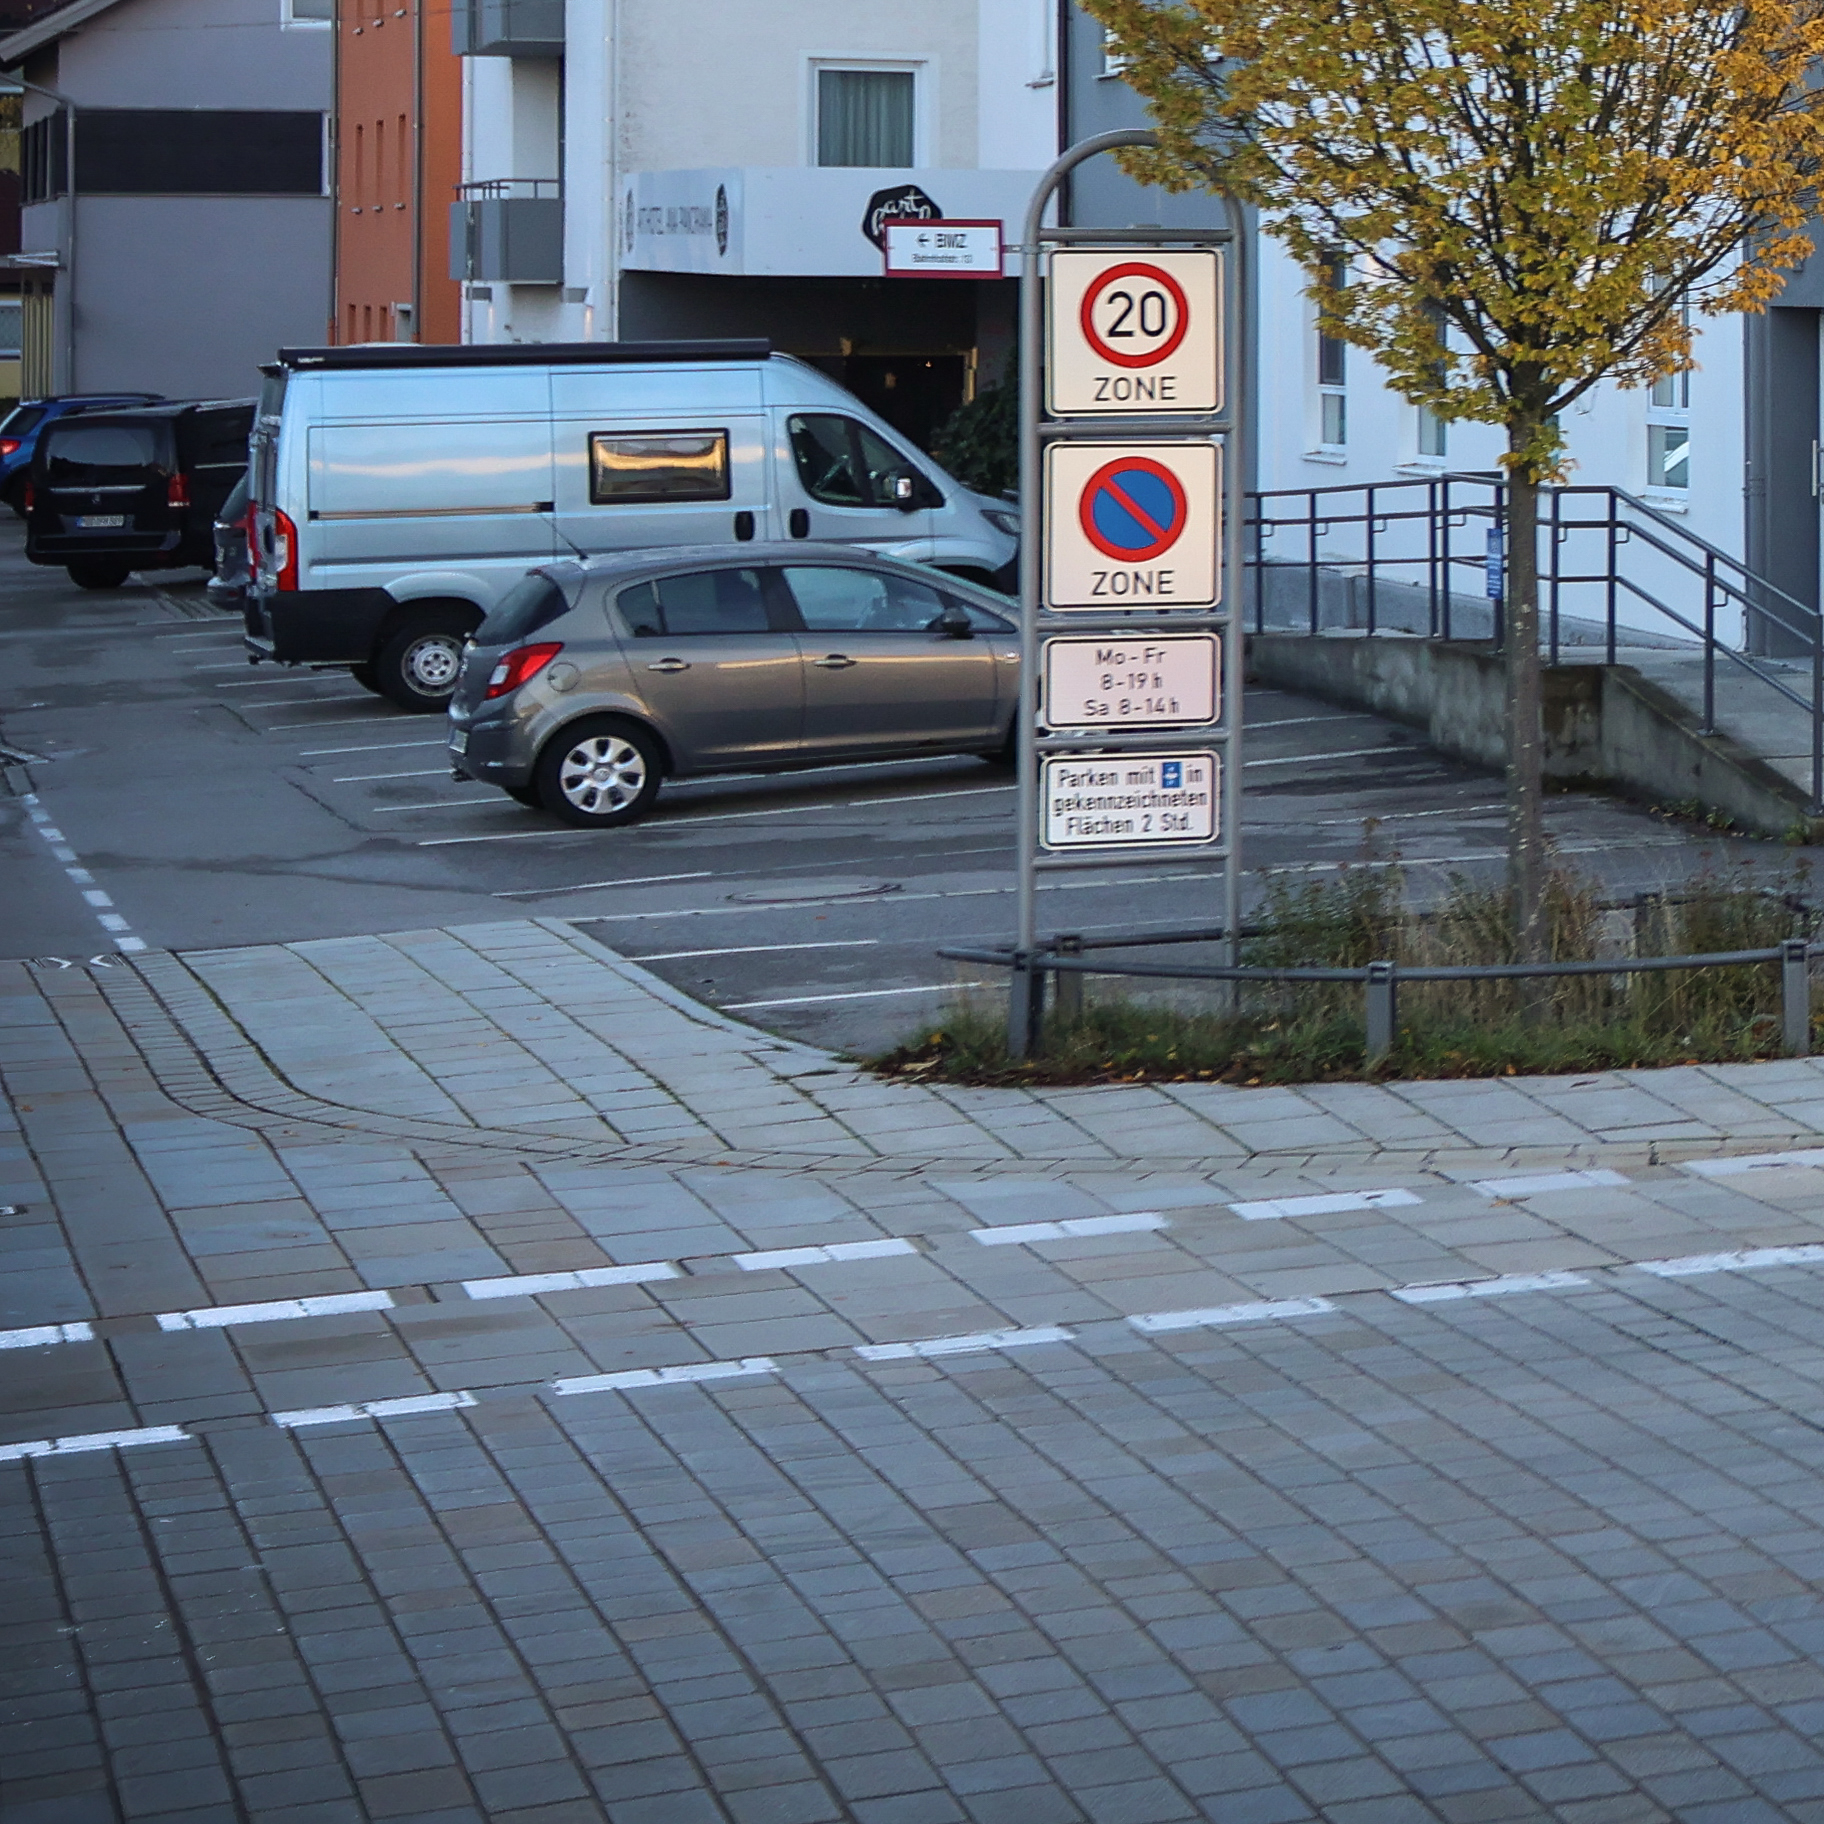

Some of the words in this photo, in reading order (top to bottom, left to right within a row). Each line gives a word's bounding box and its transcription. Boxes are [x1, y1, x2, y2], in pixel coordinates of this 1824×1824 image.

[884, 188, 924, 214] art
[1106, 291, 1165, 338] 20
[1093, 375, 1178, 402] ZONE
[1091, 570, 1176, 596] ZONE
[1084, 699, 1109, 717] Sa
[1057, 768, 1119, 788] Parken
[1125, 765, 1156, 786] mit
[1185, 763, 1203, 784] in
[1053, 789, 1208, 818] gekennzeichneten
[1065, 815, 1134, 837] Flächen
[1141, 812, 1153, 833] 2
